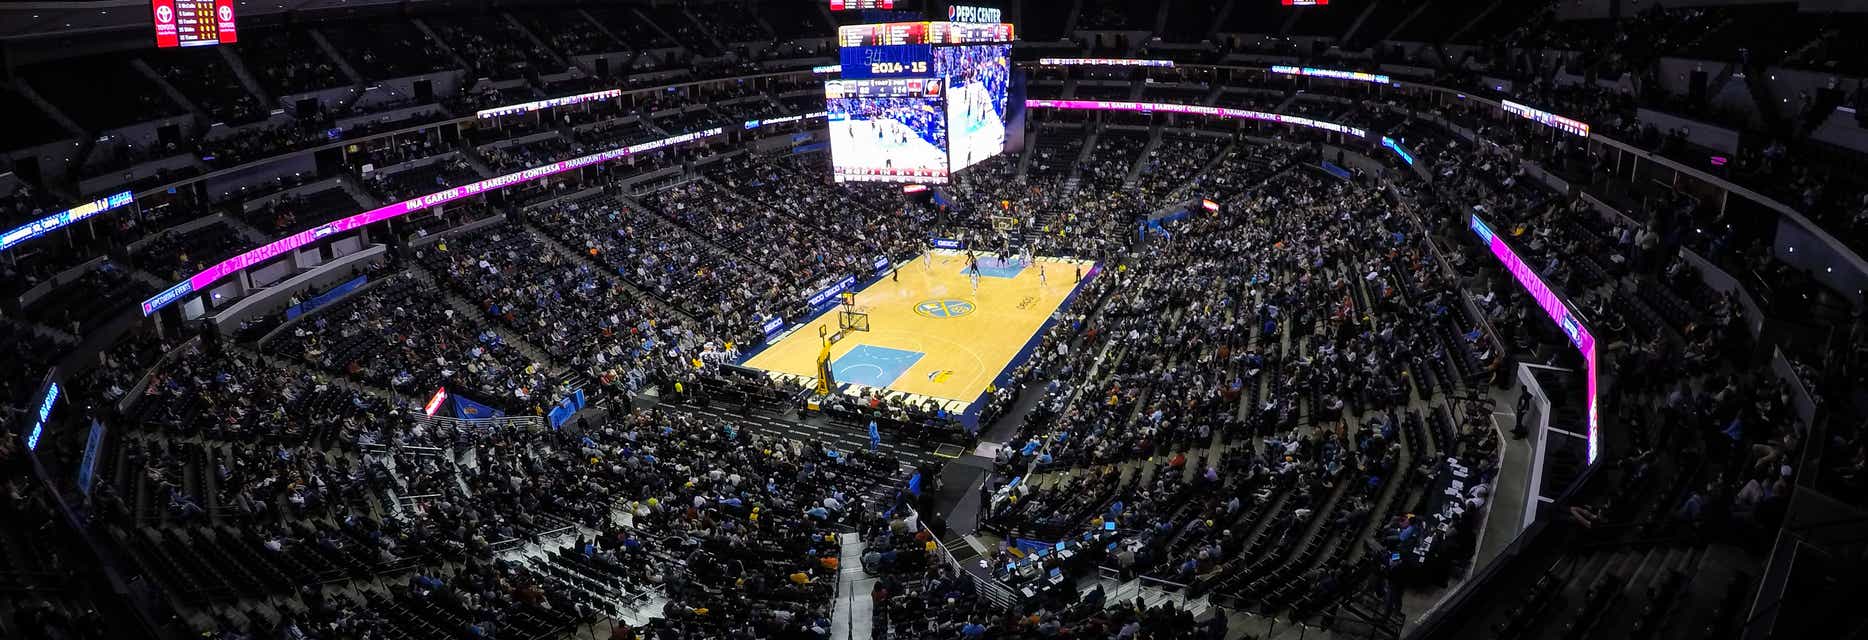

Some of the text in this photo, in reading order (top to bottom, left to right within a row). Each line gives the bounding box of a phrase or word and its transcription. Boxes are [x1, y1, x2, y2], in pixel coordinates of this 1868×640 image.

[956, 5, 1001, 23] PEPSI CENTER
[871, 62, 903, 73] 2014
[911, 61, 927, 72] 15
[1110, 102, 1137, 110] GARTEN
[1154, 104, 1186, 112] BAREFOOT
[1187, 106, 1218, 115] CONTESSA
[1224, 109, 1255, 119] PARAMOUNT
[1256, 112, 1276, 121] THEATRE
[1314, 120, 1341, 132] NOVEMBER
[406, 199, 423, 211] INA
[424, 190, 459, 205] GARTEN
[465, 184, 481, 194] THE
[481, 174, 521, 190] BAREFOOT
[523, 165, 560, 179] CONTESSA
[565, 156, 601, 169] PARAMOUNT
[601, 149, 625, 160] THEATRE
[665, 133, 693, 145] NOVEMBER
[875, 258, 888, 268] GEICO
[152, 282, 191, 308] UPCOMING EVENTS
[825, 284, 840, 298] GEICO
[764, 317, 782, 332] GEICO
